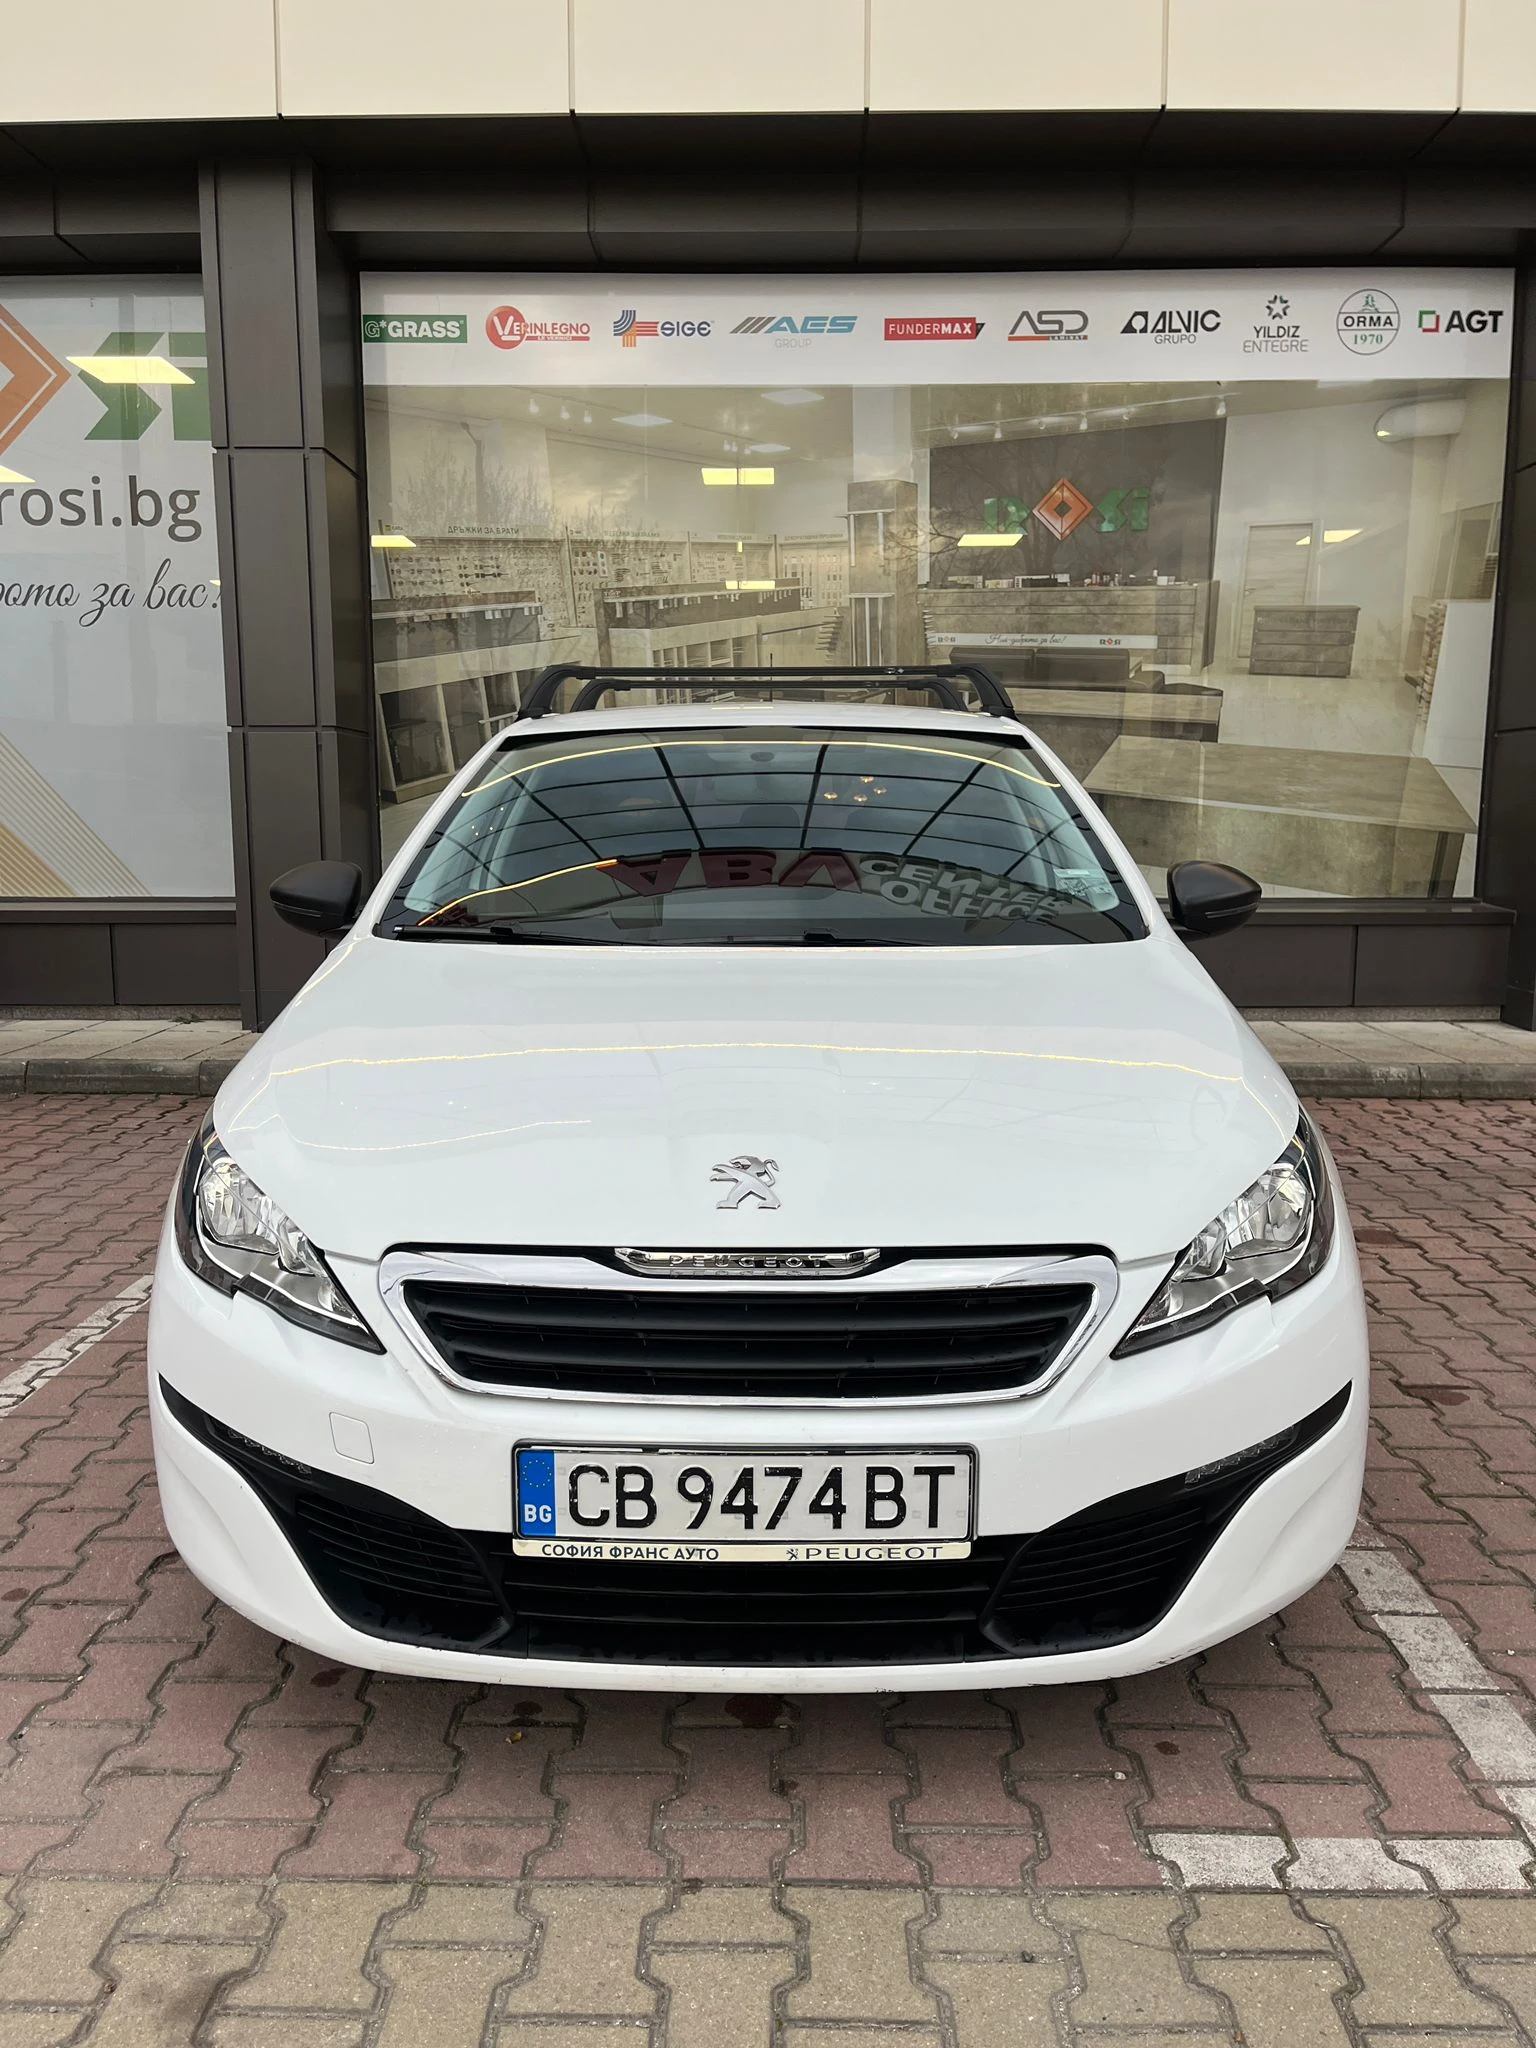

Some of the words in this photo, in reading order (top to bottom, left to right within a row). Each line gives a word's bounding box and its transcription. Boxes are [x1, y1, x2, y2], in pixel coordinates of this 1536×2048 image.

[660, 320, 711, 337] SIGE
[1009, 310, 1088, 335] ASD
[1150, 309, 1221, 333] ALVIC
[1343, 316, 1394, 328] ORMA
[1445, 309, 1504, 333] AGT
[889, 323, 972, 335] FUNDERMAX
[1254, 325, 1300, 339] YILDIZ
[775, 338, 812, 349] GROUP
[1154, 334, 1196, 345] GRUPO
[1243, 339, 1309, 353] ENTEGRE
[1353, 333, 1384, 345] 1970
[669, 1254, 827, 1269] PEUGEOT
[524, 1504, 552, 1524] BG
[568, 1464, 658, 1528] CB
[677, 1466, 848, 1530] 9474
[865, 1465, 956, 1530] BT
[541, 1543, 604, 1559] СОФИЯ
[609, 1545, 669, 1561] ФРАНС
[673, 1547, 719, 1561] АУТО
[806, 1546, 944, 1561] PEUGEOT
